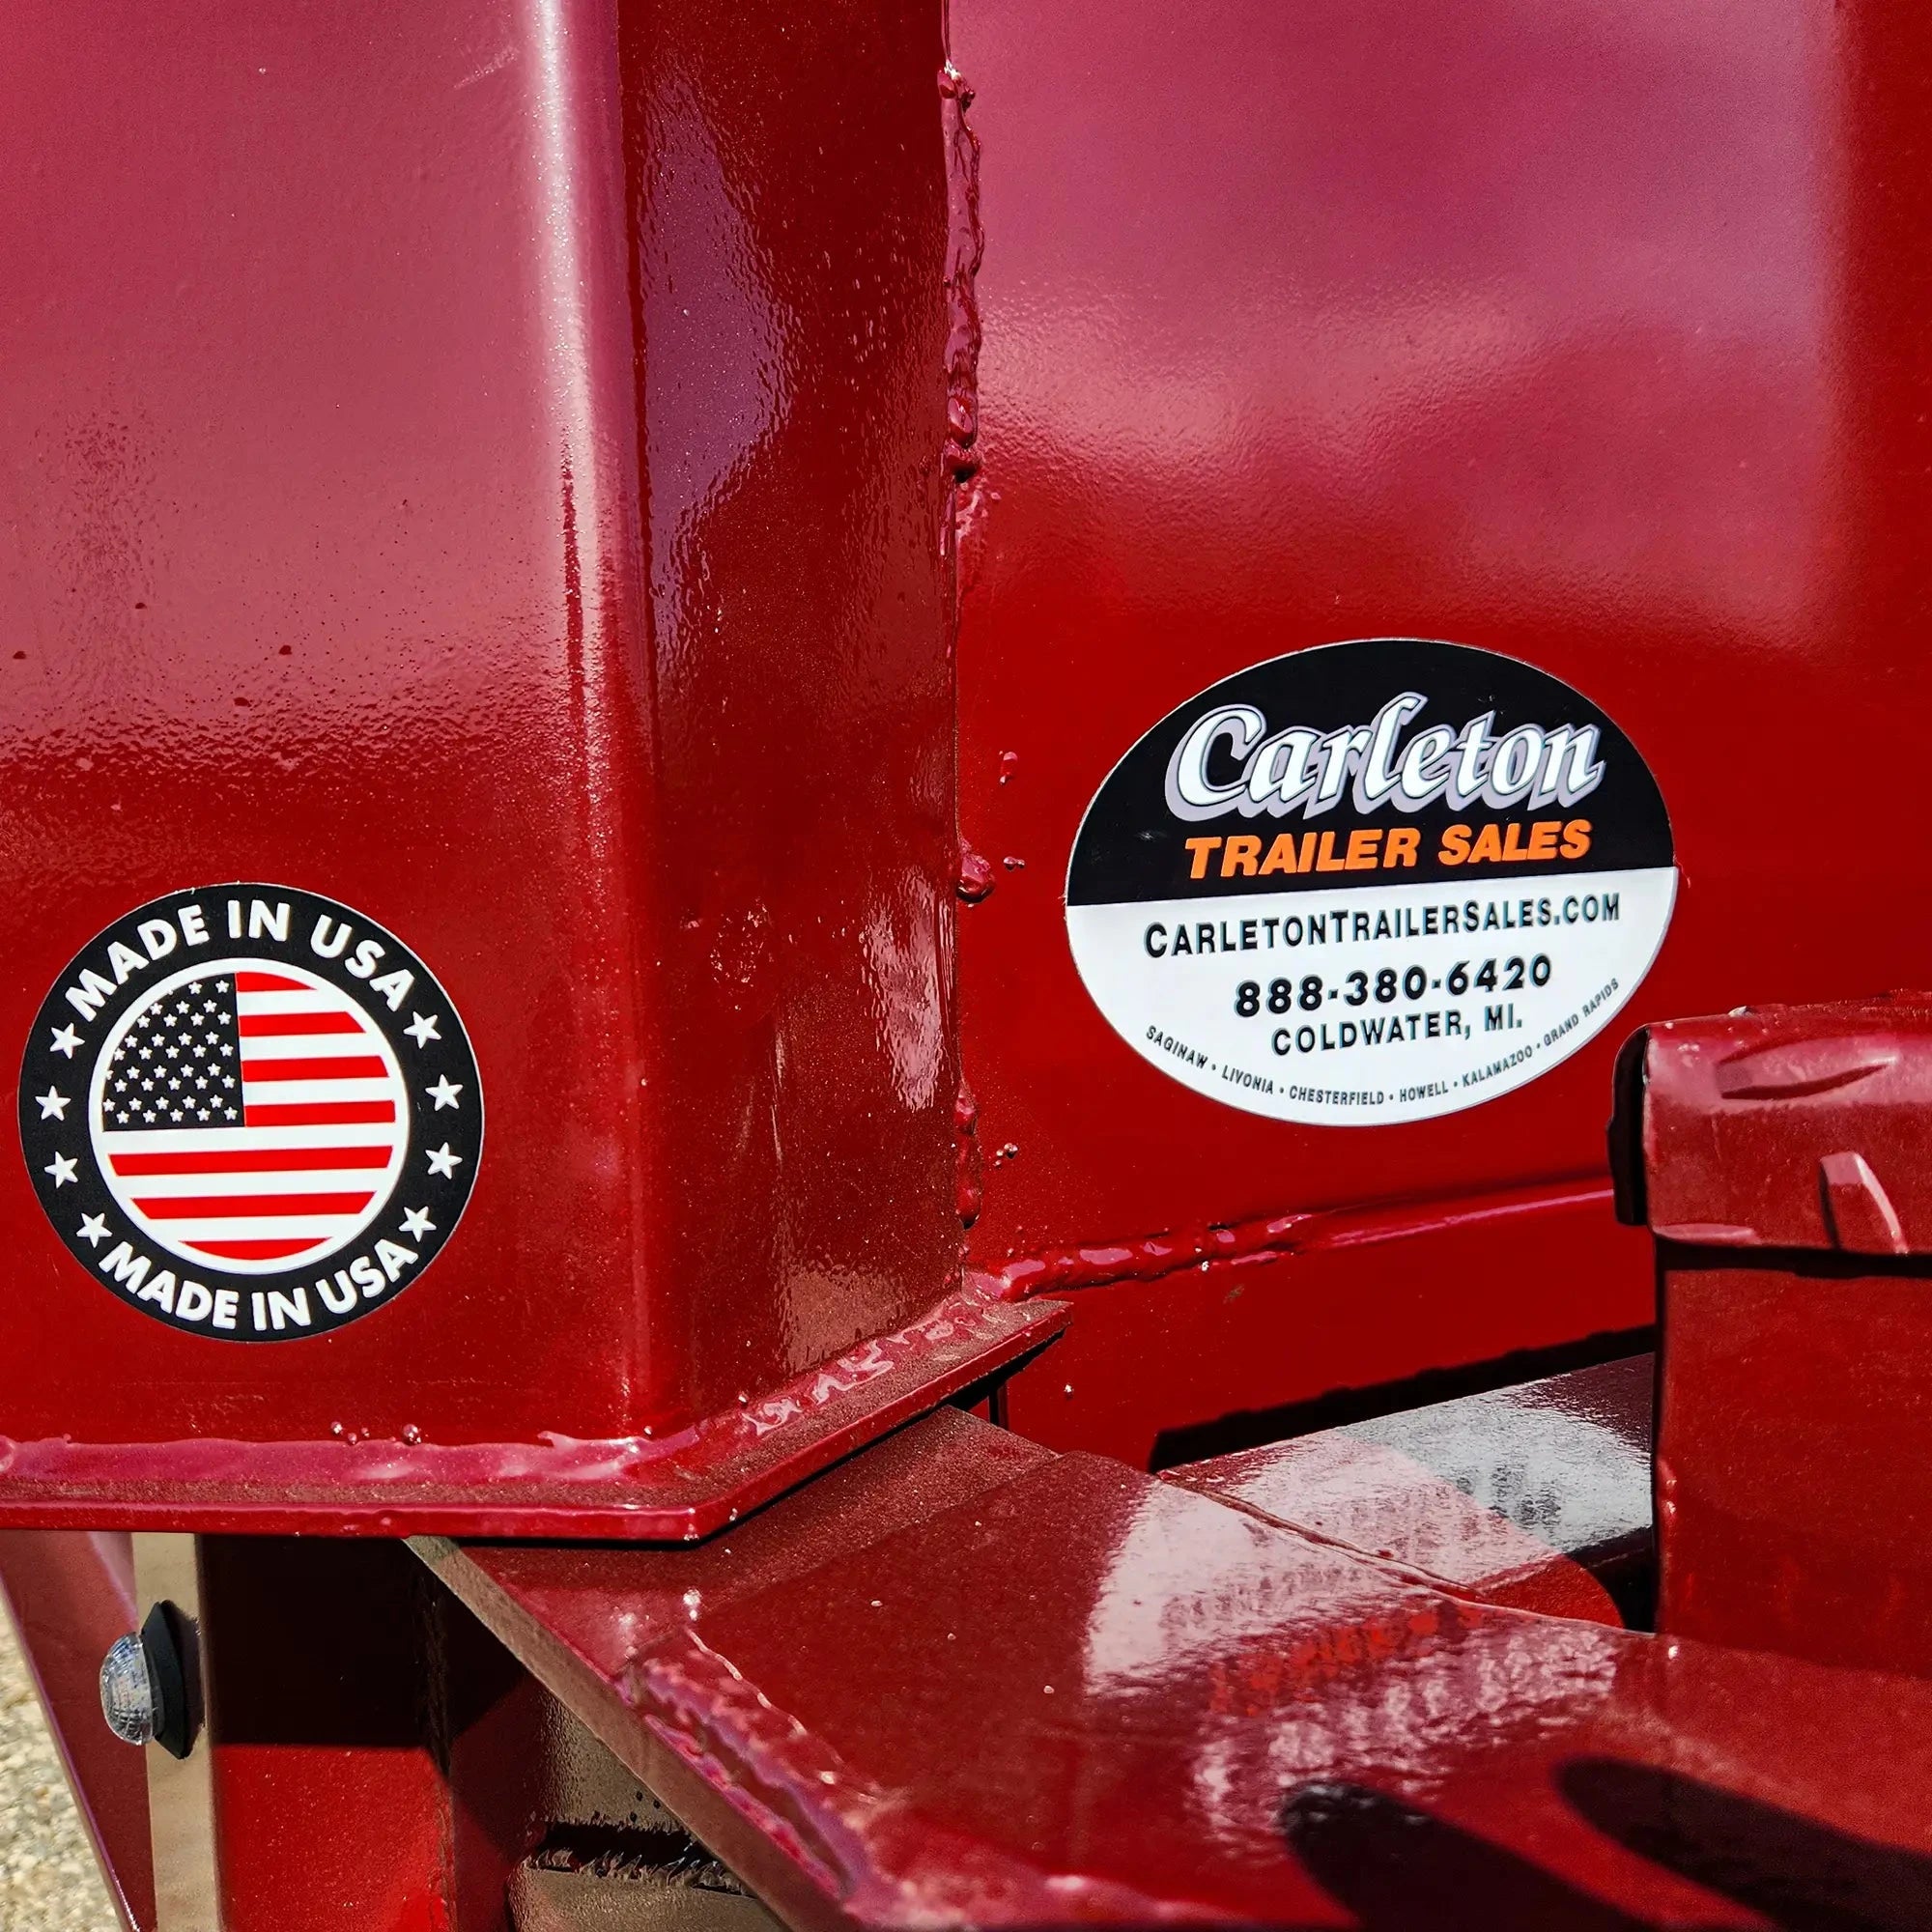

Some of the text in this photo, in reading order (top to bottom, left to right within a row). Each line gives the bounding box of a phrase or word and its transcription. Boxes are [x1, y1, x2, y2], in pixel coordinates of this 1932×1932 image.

[1164, 691, 1608, 822] Carleton
[1185, 819, 1593, 880] TRAILER SALES
[65, 900, 414, 1022] MADE IN USA
[1234, 955, 1551, 1018] 888-380-6420
[1146, 978, 1620, 1106] SAGINAW LIVONIA CHESTERFIELD HOWELL KALAMAZOO GRAND RAPIDS
[1271, 1003, 1522, 1056] COLDWATER, MI.
[98, 1238, 418, 1331] MADE IN USA
